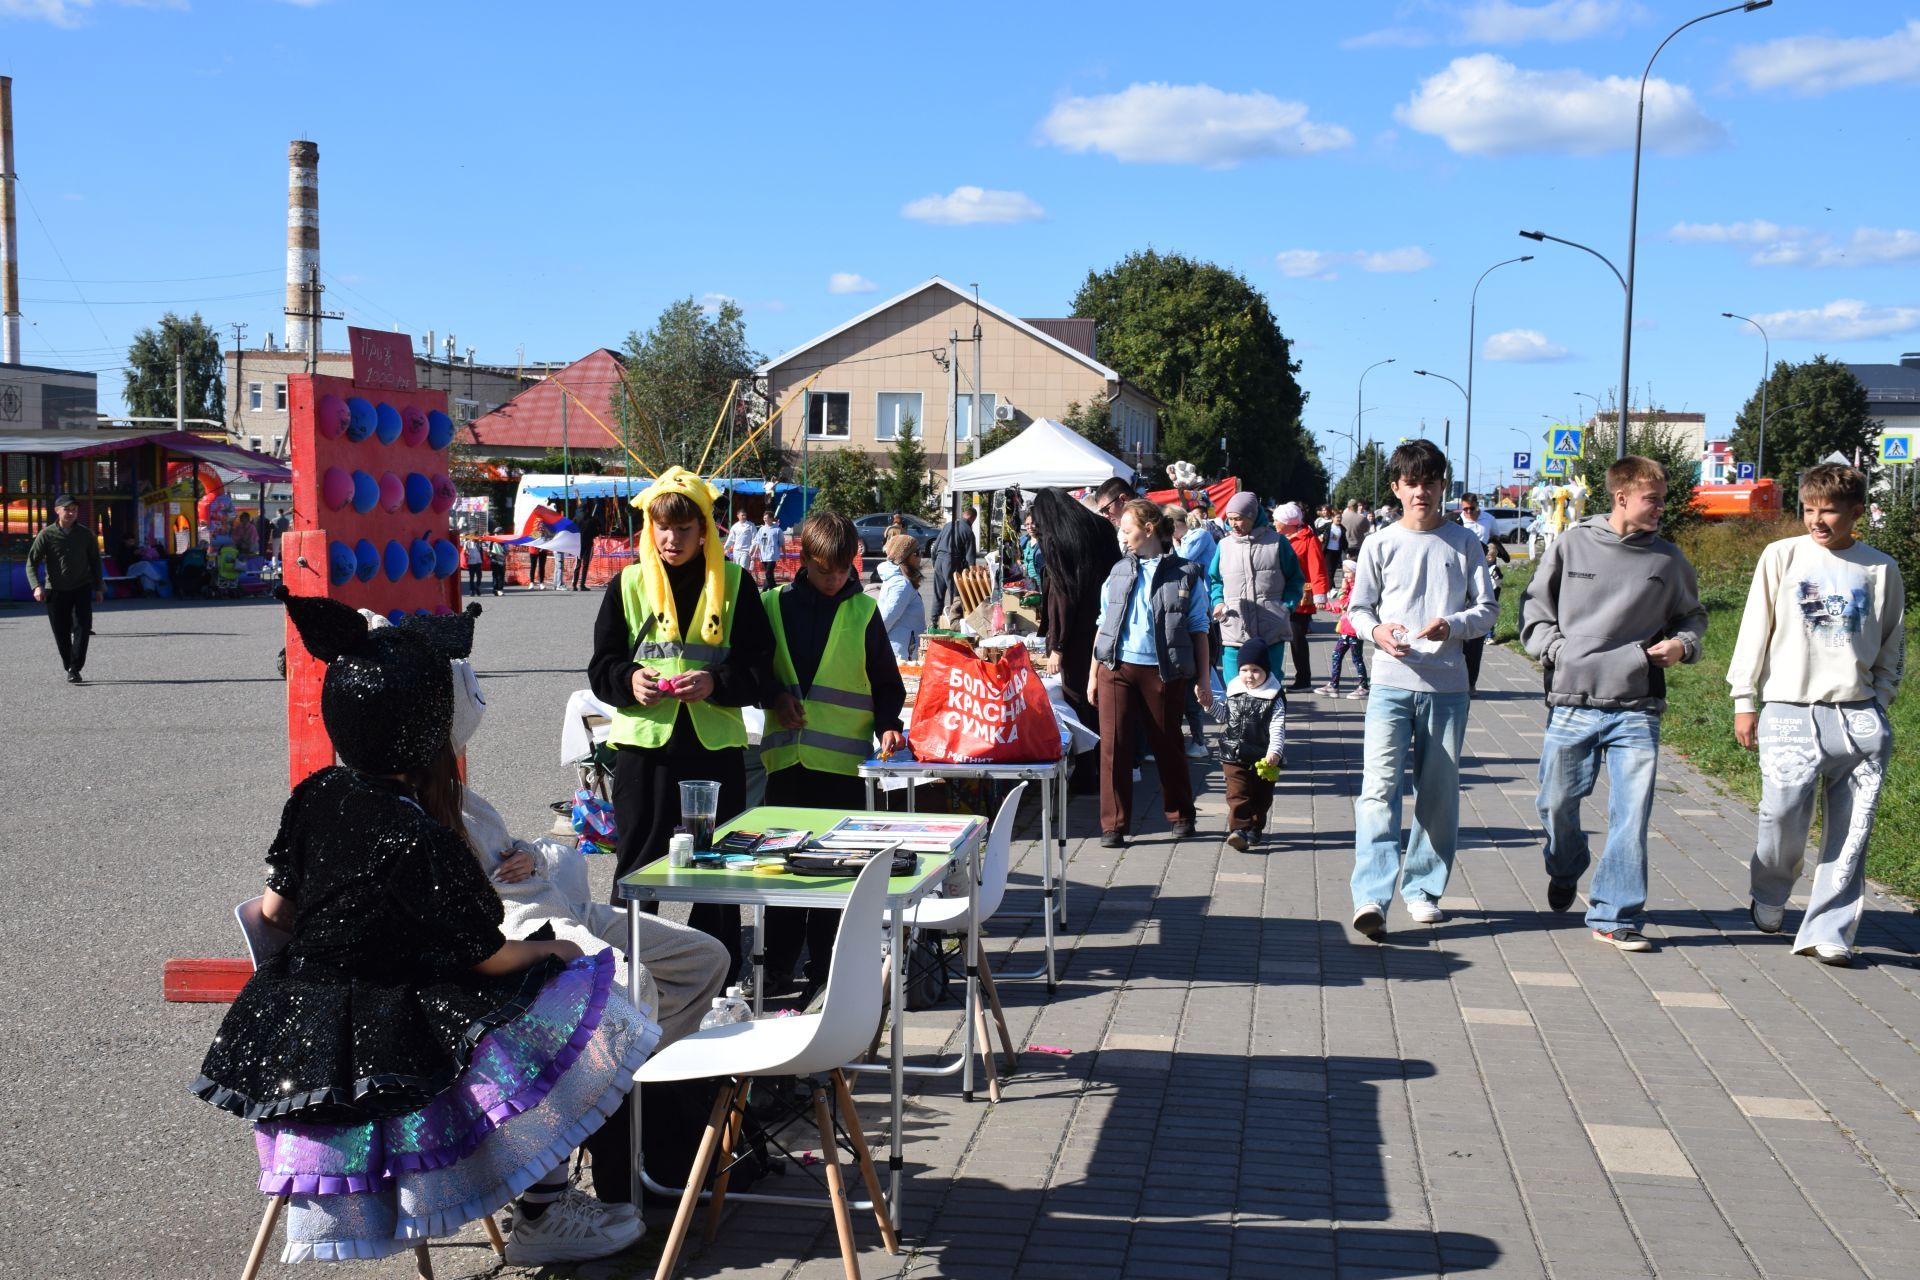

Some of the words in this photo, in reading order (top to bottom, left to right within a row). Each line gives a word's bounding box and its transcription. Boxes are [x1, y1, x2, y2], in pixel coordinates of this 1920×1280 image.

[1517, 453, 1529, 468] P
[1741, 464, 1752, 478] P
[943, 711, 1019, 744] СУМКА
